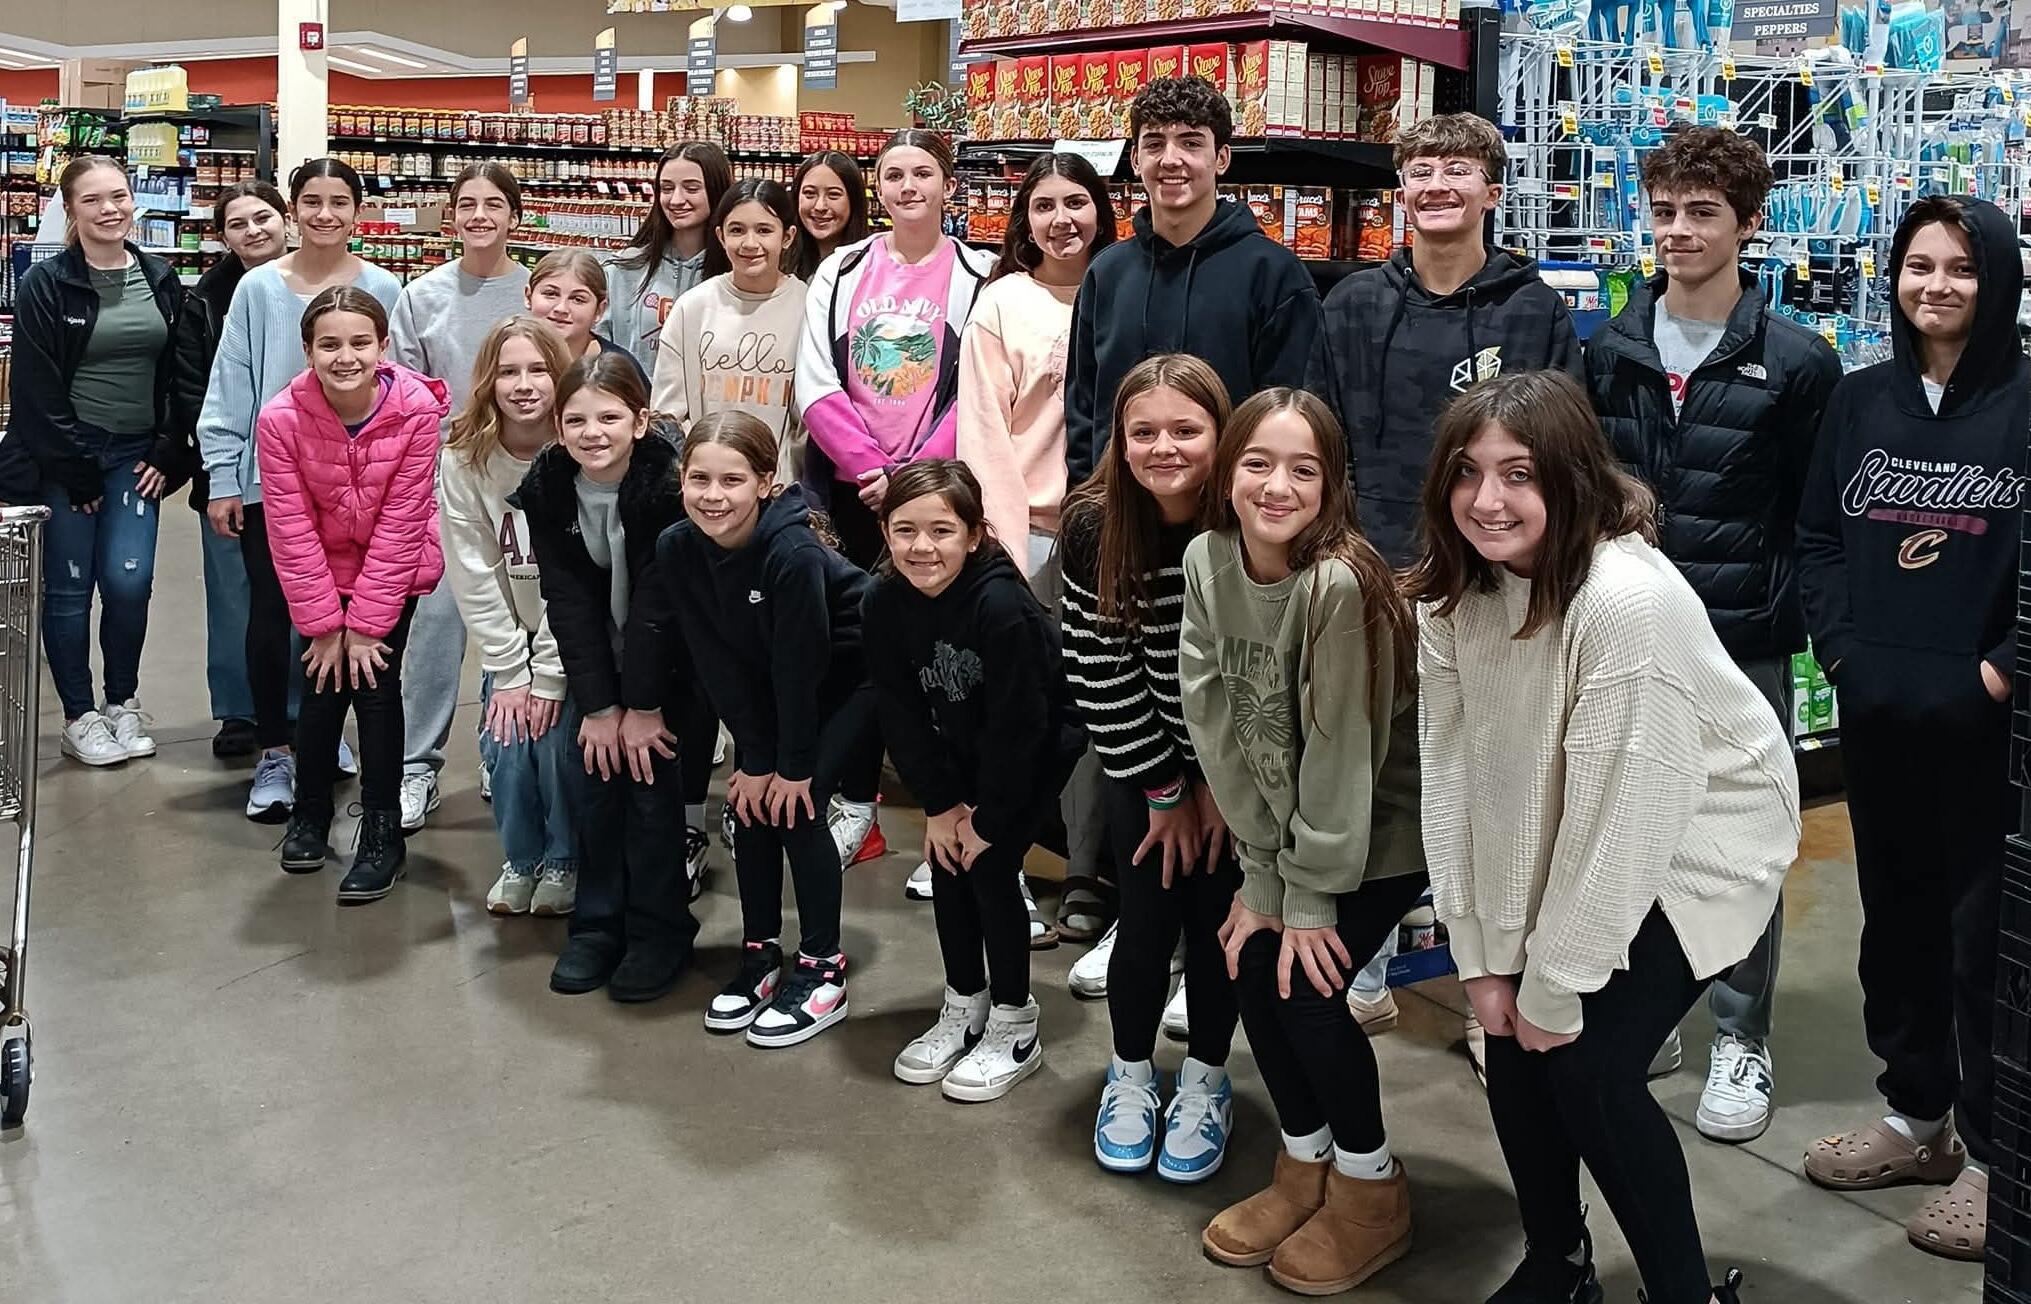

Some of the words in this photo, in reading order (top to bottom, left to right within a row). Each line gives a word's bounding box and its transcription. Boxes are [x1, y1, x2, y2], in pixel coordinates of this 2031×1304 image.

[1743, 2, 1820, 18] SPECIALTIES
[1753, 22, 1808, 36] PEPPERS
[1021, 66, 1045, 93] Stove
[1052, 64, 1077, 92] Stove
[1082, 62, 1109, 90] Stove
[1114, 60, 1143, 89] Stove
[1152, 56, 1178, 80] Stove
[1193, 55, 1221, 77] Stove
[1238, 53, 1263, 84] Stove
[1364, 65, 1396, 93] Stove
[857, 296, 896, 317] OLD
[699, 331, 795, 373] hello
[1891, 457, 1957, 473] CLEVELAND
[1842, 448, 2027, 516] Cavaliers
